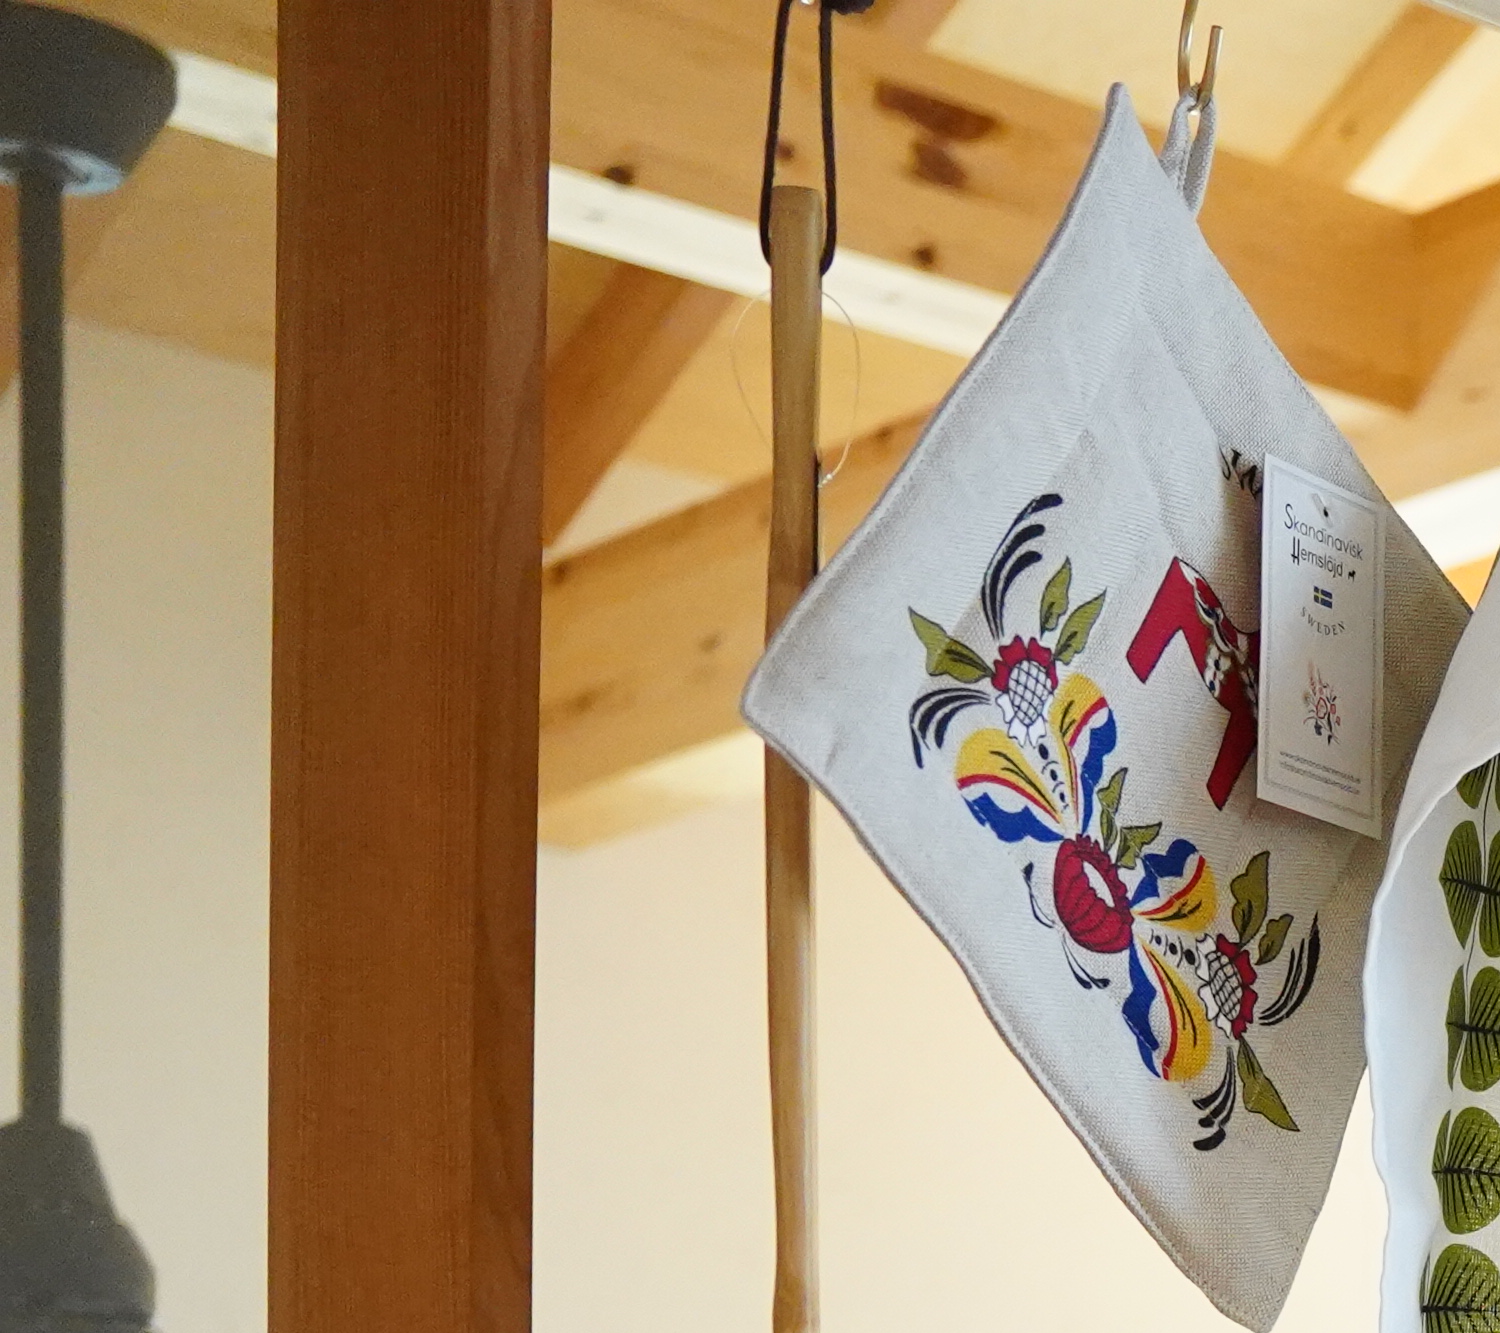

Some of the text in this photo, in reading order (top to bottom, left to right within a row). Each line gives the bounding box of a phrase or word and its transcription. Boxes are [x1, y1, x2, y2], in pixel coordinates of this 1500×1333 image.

[1284, 503, 1363, 561] Skandinavisk
[1290, 536, 1344, 578] Hemslöjd
[1301, 606, 1346, 636] SWEDEN
